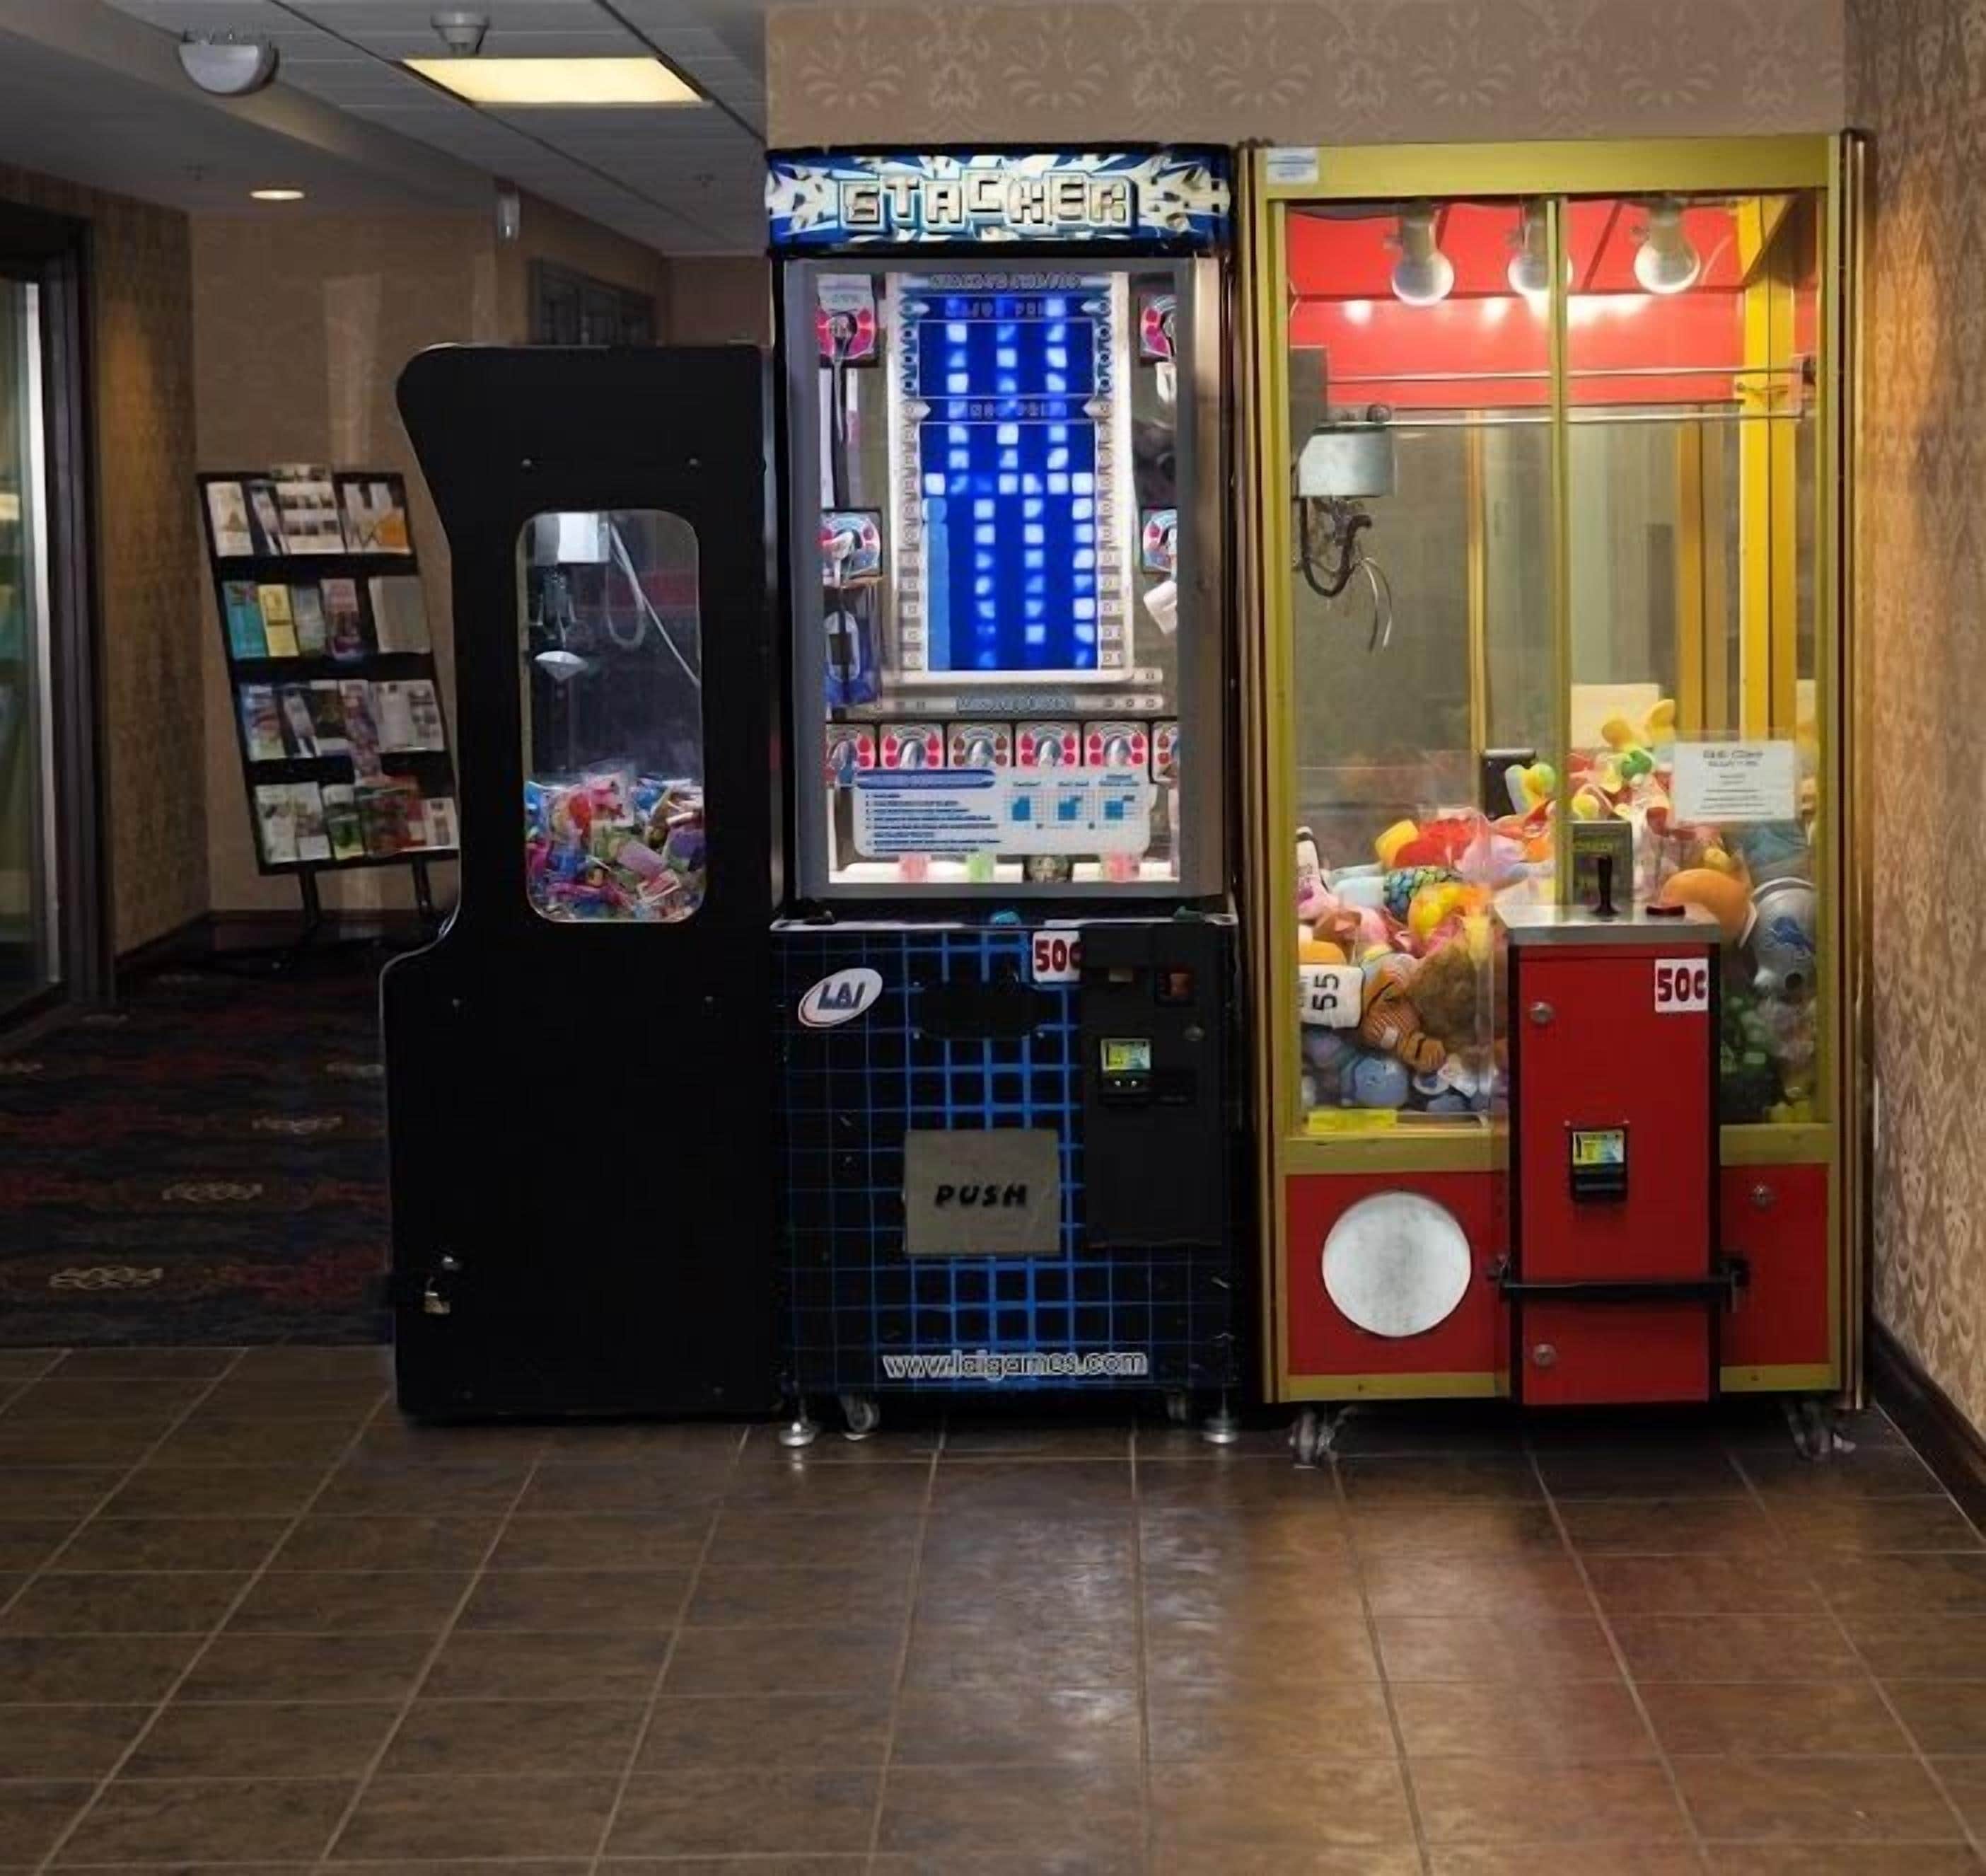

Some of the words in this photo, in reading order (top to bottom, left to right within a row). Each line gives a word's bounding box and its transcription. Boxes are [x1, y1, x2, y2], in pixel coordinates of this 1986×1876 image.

[842, 171, 1127, 224] STACKER
[818, 981, 866, 1010] LAI
[934, 1183, 1028, 1208] PUSH
[882, 1348, 1149, 1382] www.laigames.com
